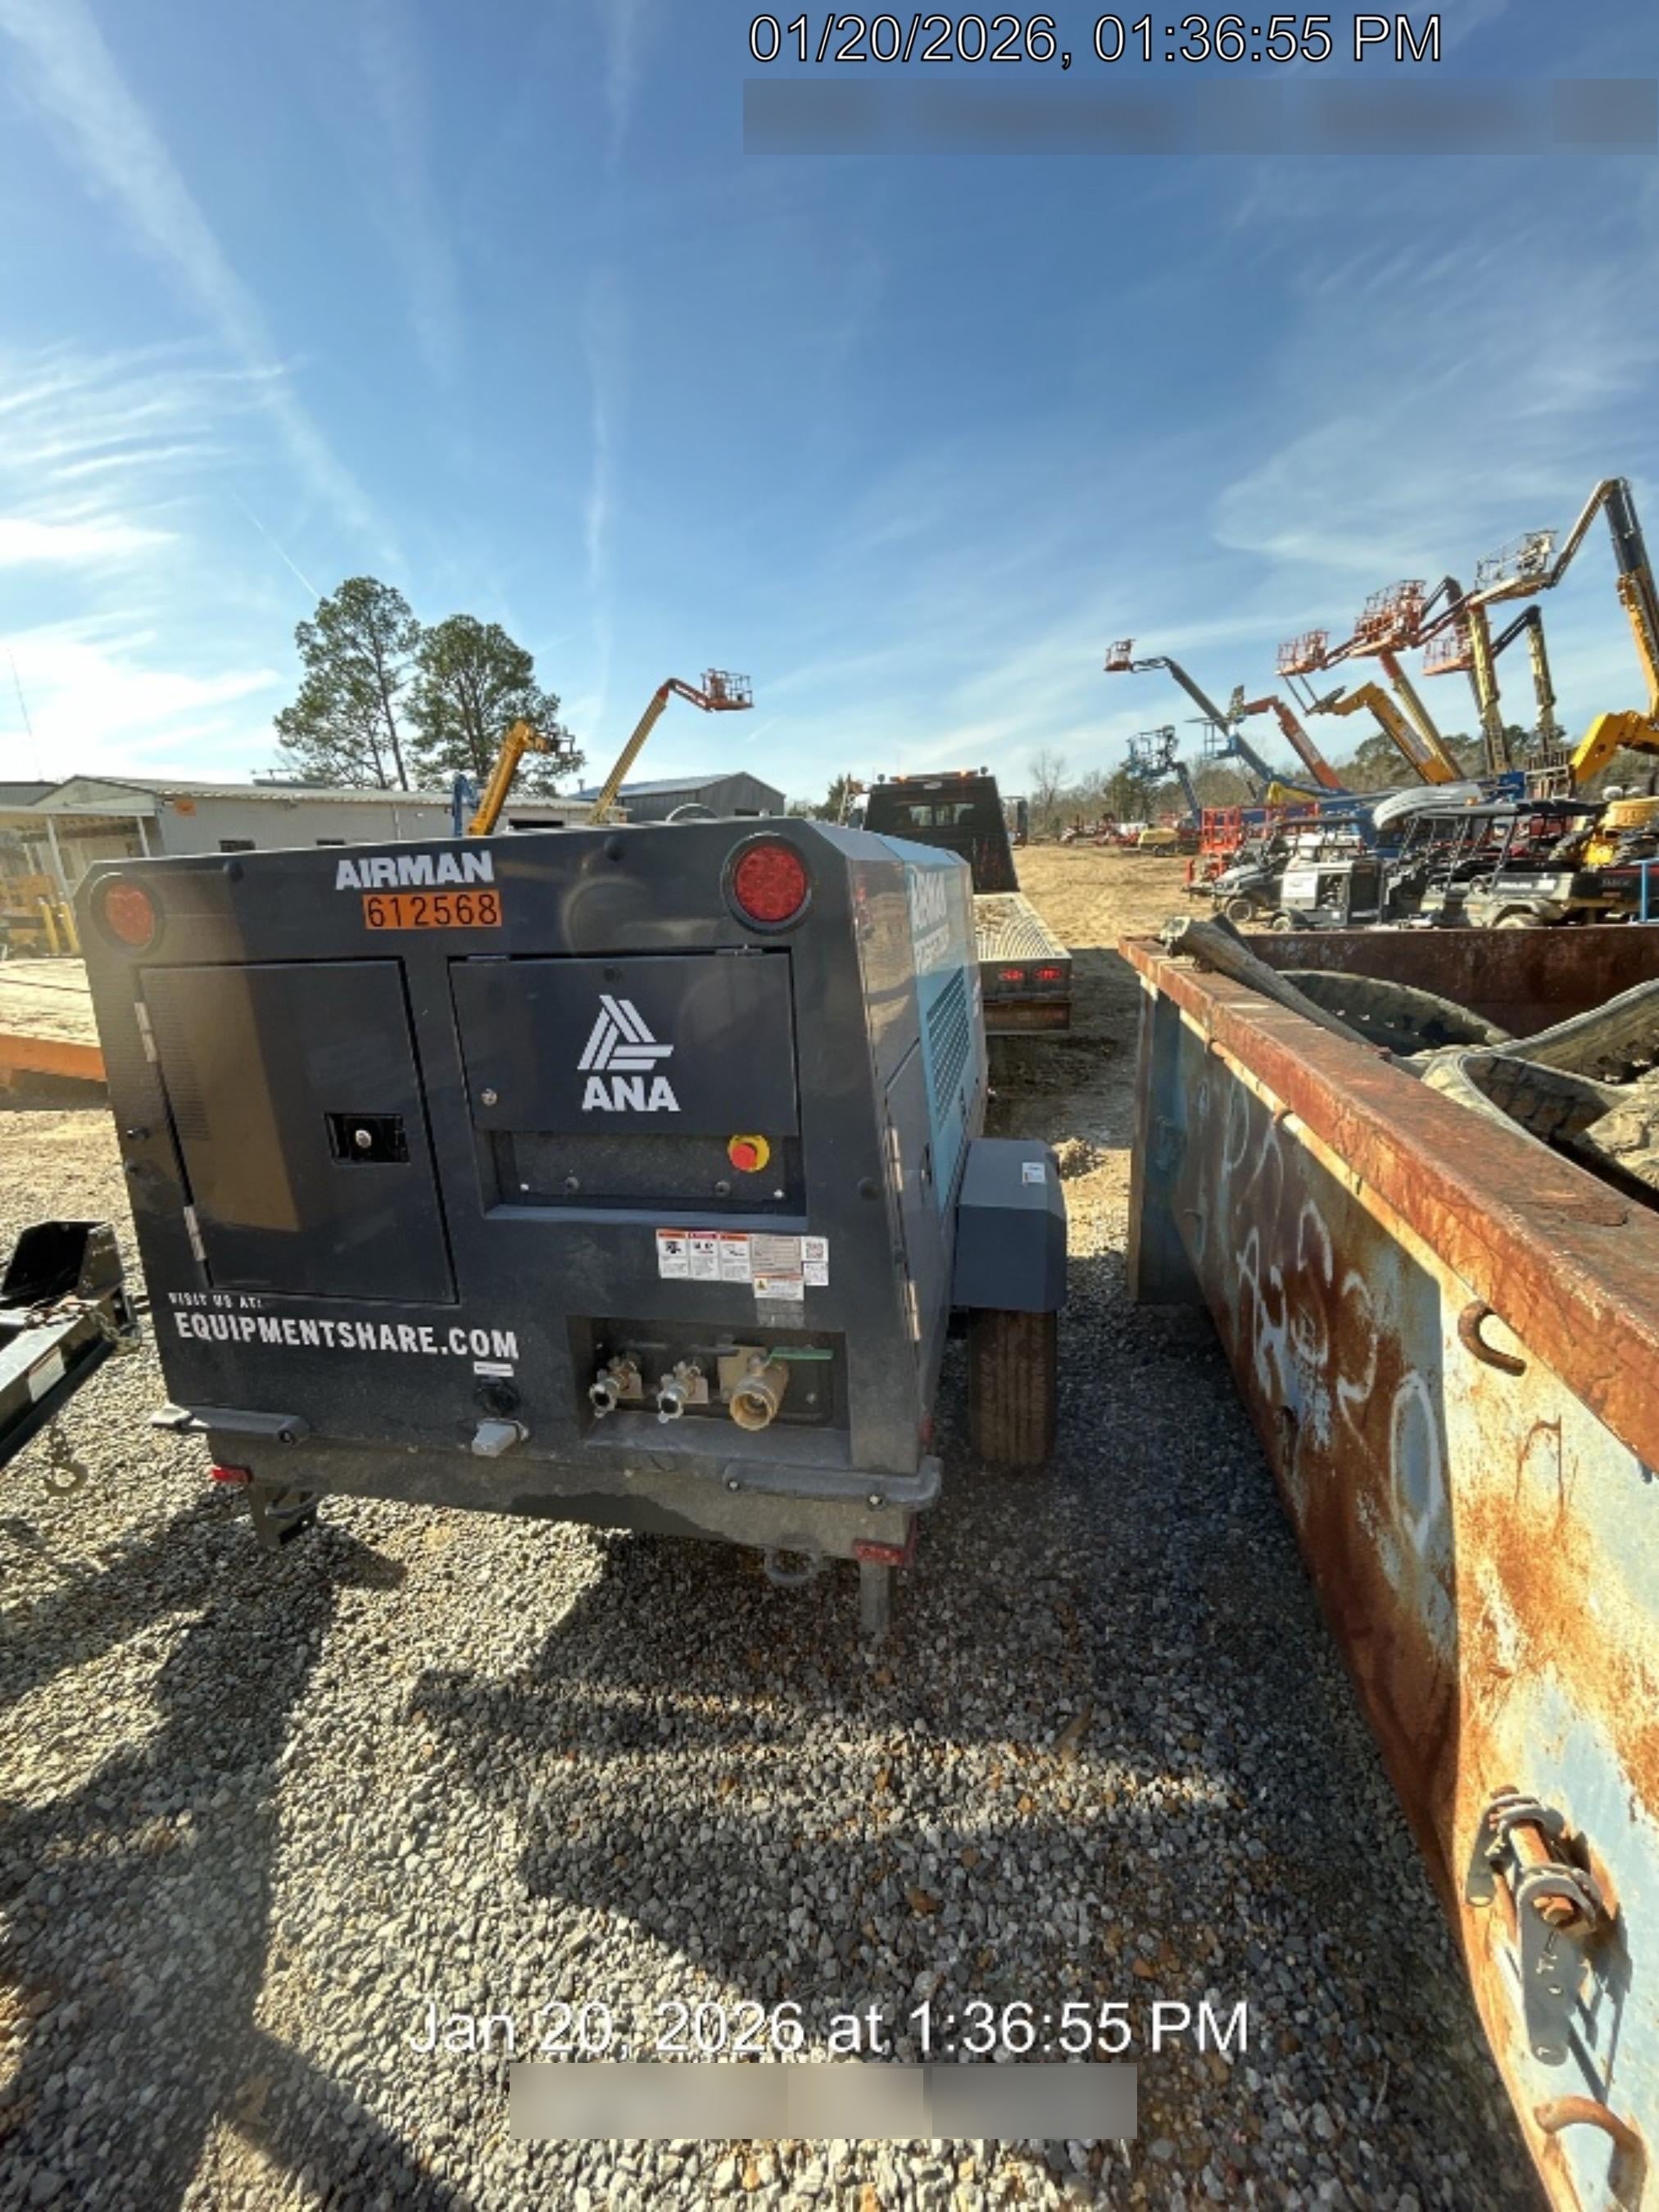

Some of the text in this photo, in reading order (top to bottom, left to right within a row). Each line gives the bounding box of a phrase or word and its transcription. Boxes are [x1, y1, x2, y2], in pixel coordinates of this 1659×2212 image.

[335, 850, 495, 891] AIRMAN
[368, 893, 498, 927] 612568
[582, 1076, 682, 1112] ANA
[167, 1292, 207, 1306] VISIT
[212, 1294, 233, 1308] US
[174, 1312, 519, 1360] EQUIPMENTSHARE.COM
